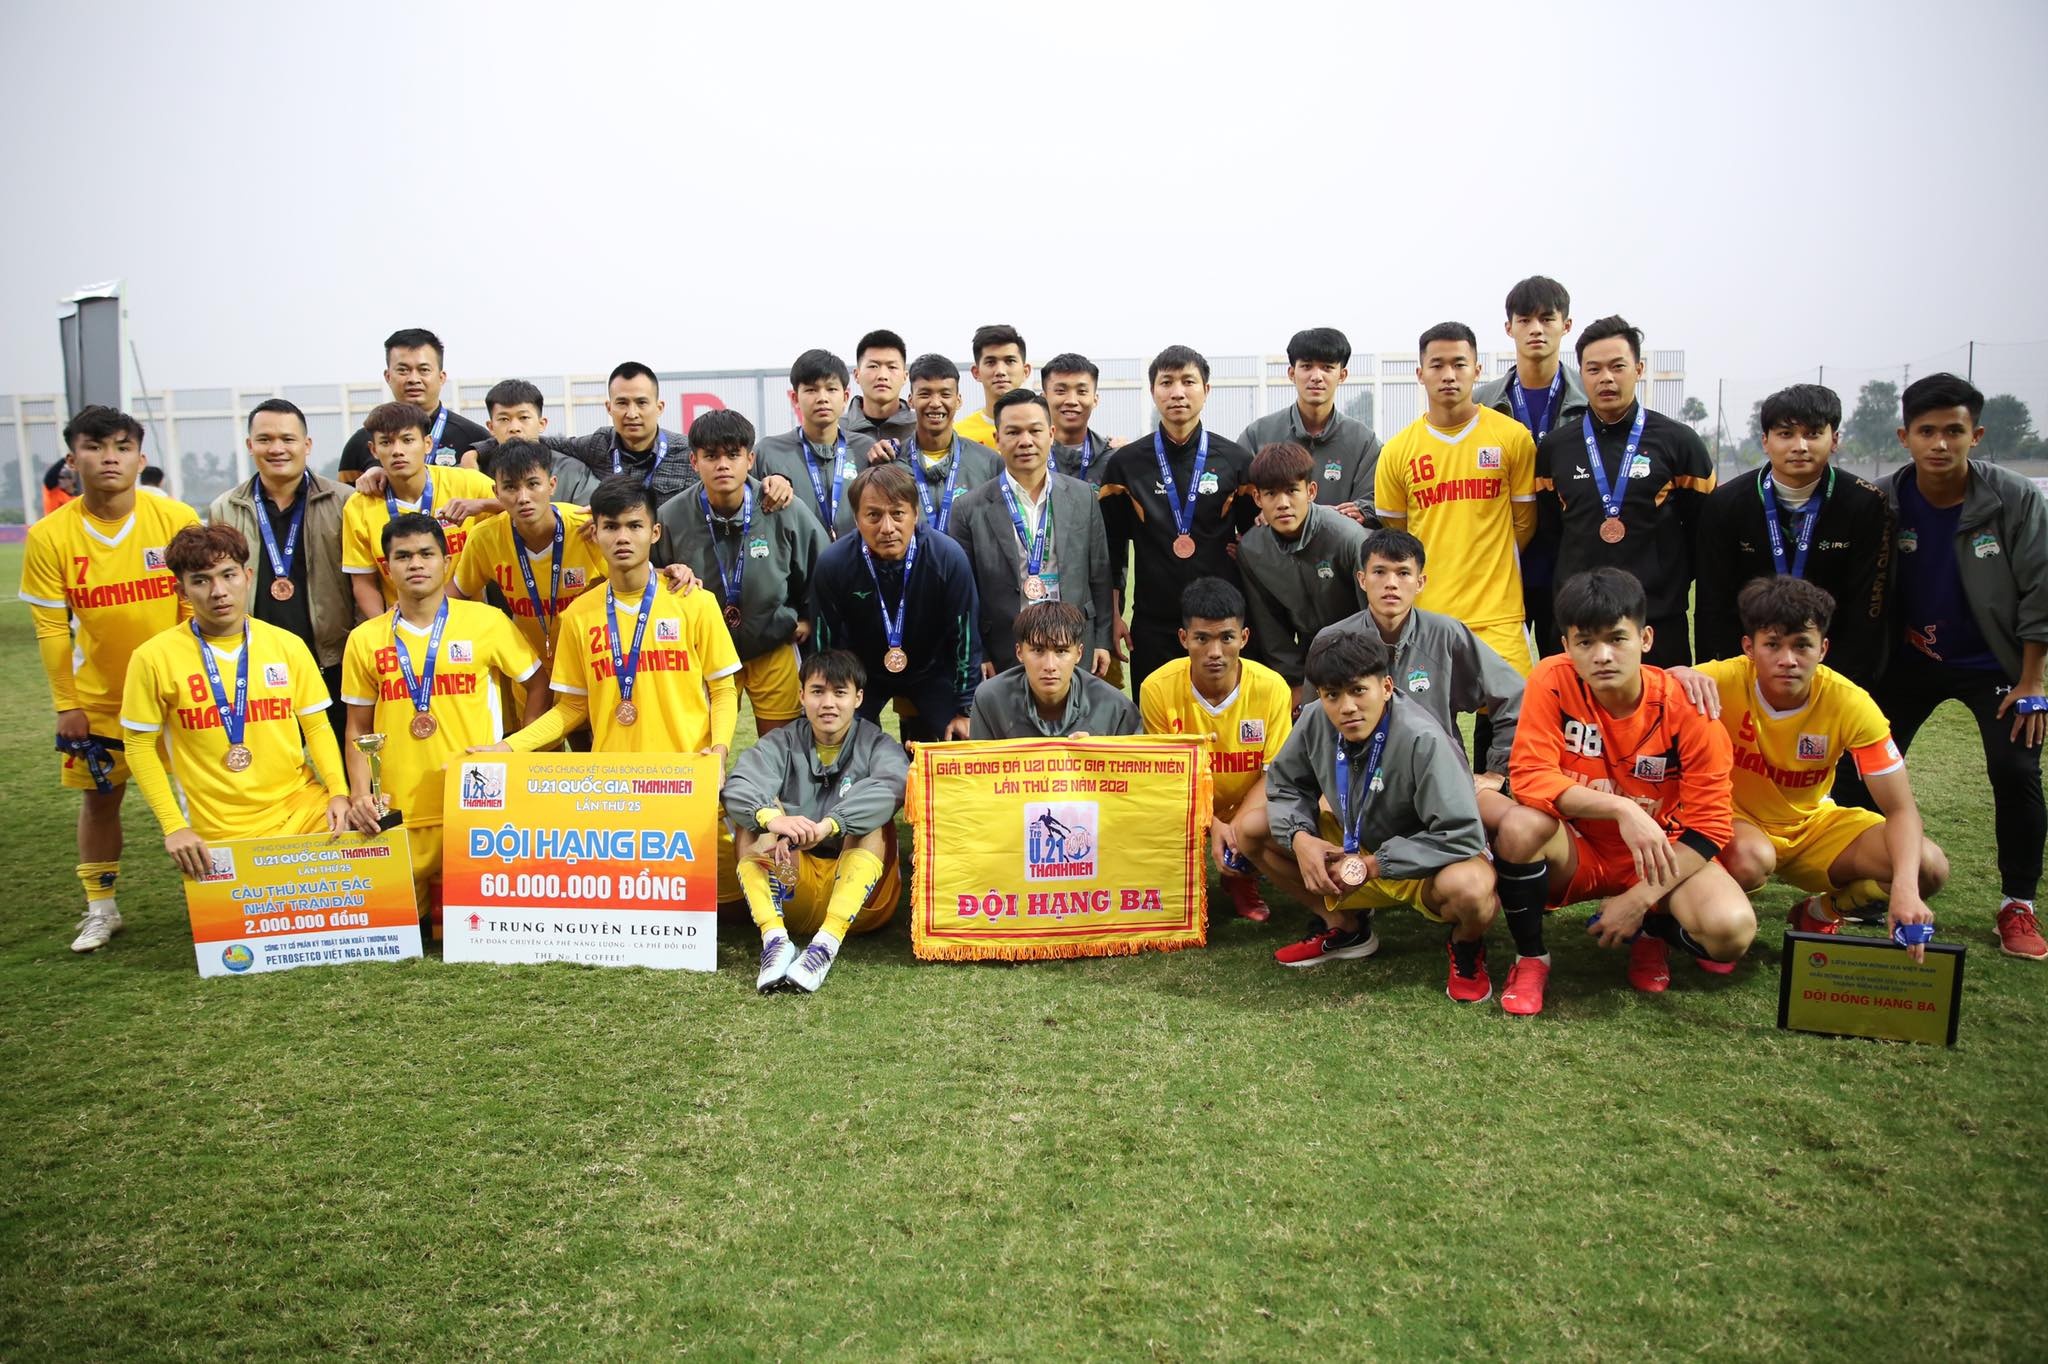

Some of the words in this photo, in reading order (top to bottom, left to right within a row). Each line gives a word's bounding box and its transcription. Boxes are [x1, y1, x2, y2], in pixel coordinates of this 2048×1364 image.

[1409, 454, 1435, 484] 16
[73, 556, 88, 584] 7
[495, 564, 514, 592] 11
[187, 673, 208, 703] 8
[1564, 720, 1602, 757] 98
[936, 758, 962, 775] GIẢI
[964, 758, 1000, 775] BÓNG
[1003, 756, 1021, 773] ĐÁ
[1084, 760, 1105, 773] GIA
[1108, 760, 1151, 773] THANH
[1154, 758, 1185, 774] NIÊN
[527, 780, 555, 793] U.21
[558, 775, 602, 794] QUỐC
[604, 780, 630, 793] GIA
[1022, 775, 1050, 793] THỨ
[1052, 780, 1068, 792] 25
[1070, 776, 1096, 792] NĂM
[1099, 780, 1128, 793] 2021
[628, 801, 641, 811] 25
[470, 823, 531, 863] ĐỘI
[536, 829, 635, 864] HẠNG
[640, 830, 695, 861] BA
[1029, 837, 1064, 864] U.21
[254, 856, 279, 866] U.21
[281, 849, 317, 864] QUỐC
[319, 851, 340, 862] GIA
[340, 864, 352, 872] 25
[299, 877, 337, 894] XUẤT
[480, 873, 611, 899] 60.000.000
[618, 868, 687, 901] ĐỒNG
[244, 899, 285, 915] NHẤT
[289, 896, 330, 911] TRẬN
[958, 889, 1018, 921] ĐỘI
[1027, 890, 1110, 919] HẠNG
[1120, 889, 1163, 911] BA
[245, 914, 326, 934] 2.000.000
[330, 910, 369, 927] đồng
[489, 921, 545, 933] TRUNG
[553, 921, 622, 934] NGUYÊN
[631, 925, 697, 937] LEGEND
[266, 951, 321, 965] PETROSETCO
[323, 948, 342, 961] VIỆT
[345, 948, 362, 959] NGA
[1917, 1001, 1937, 1012] BA
